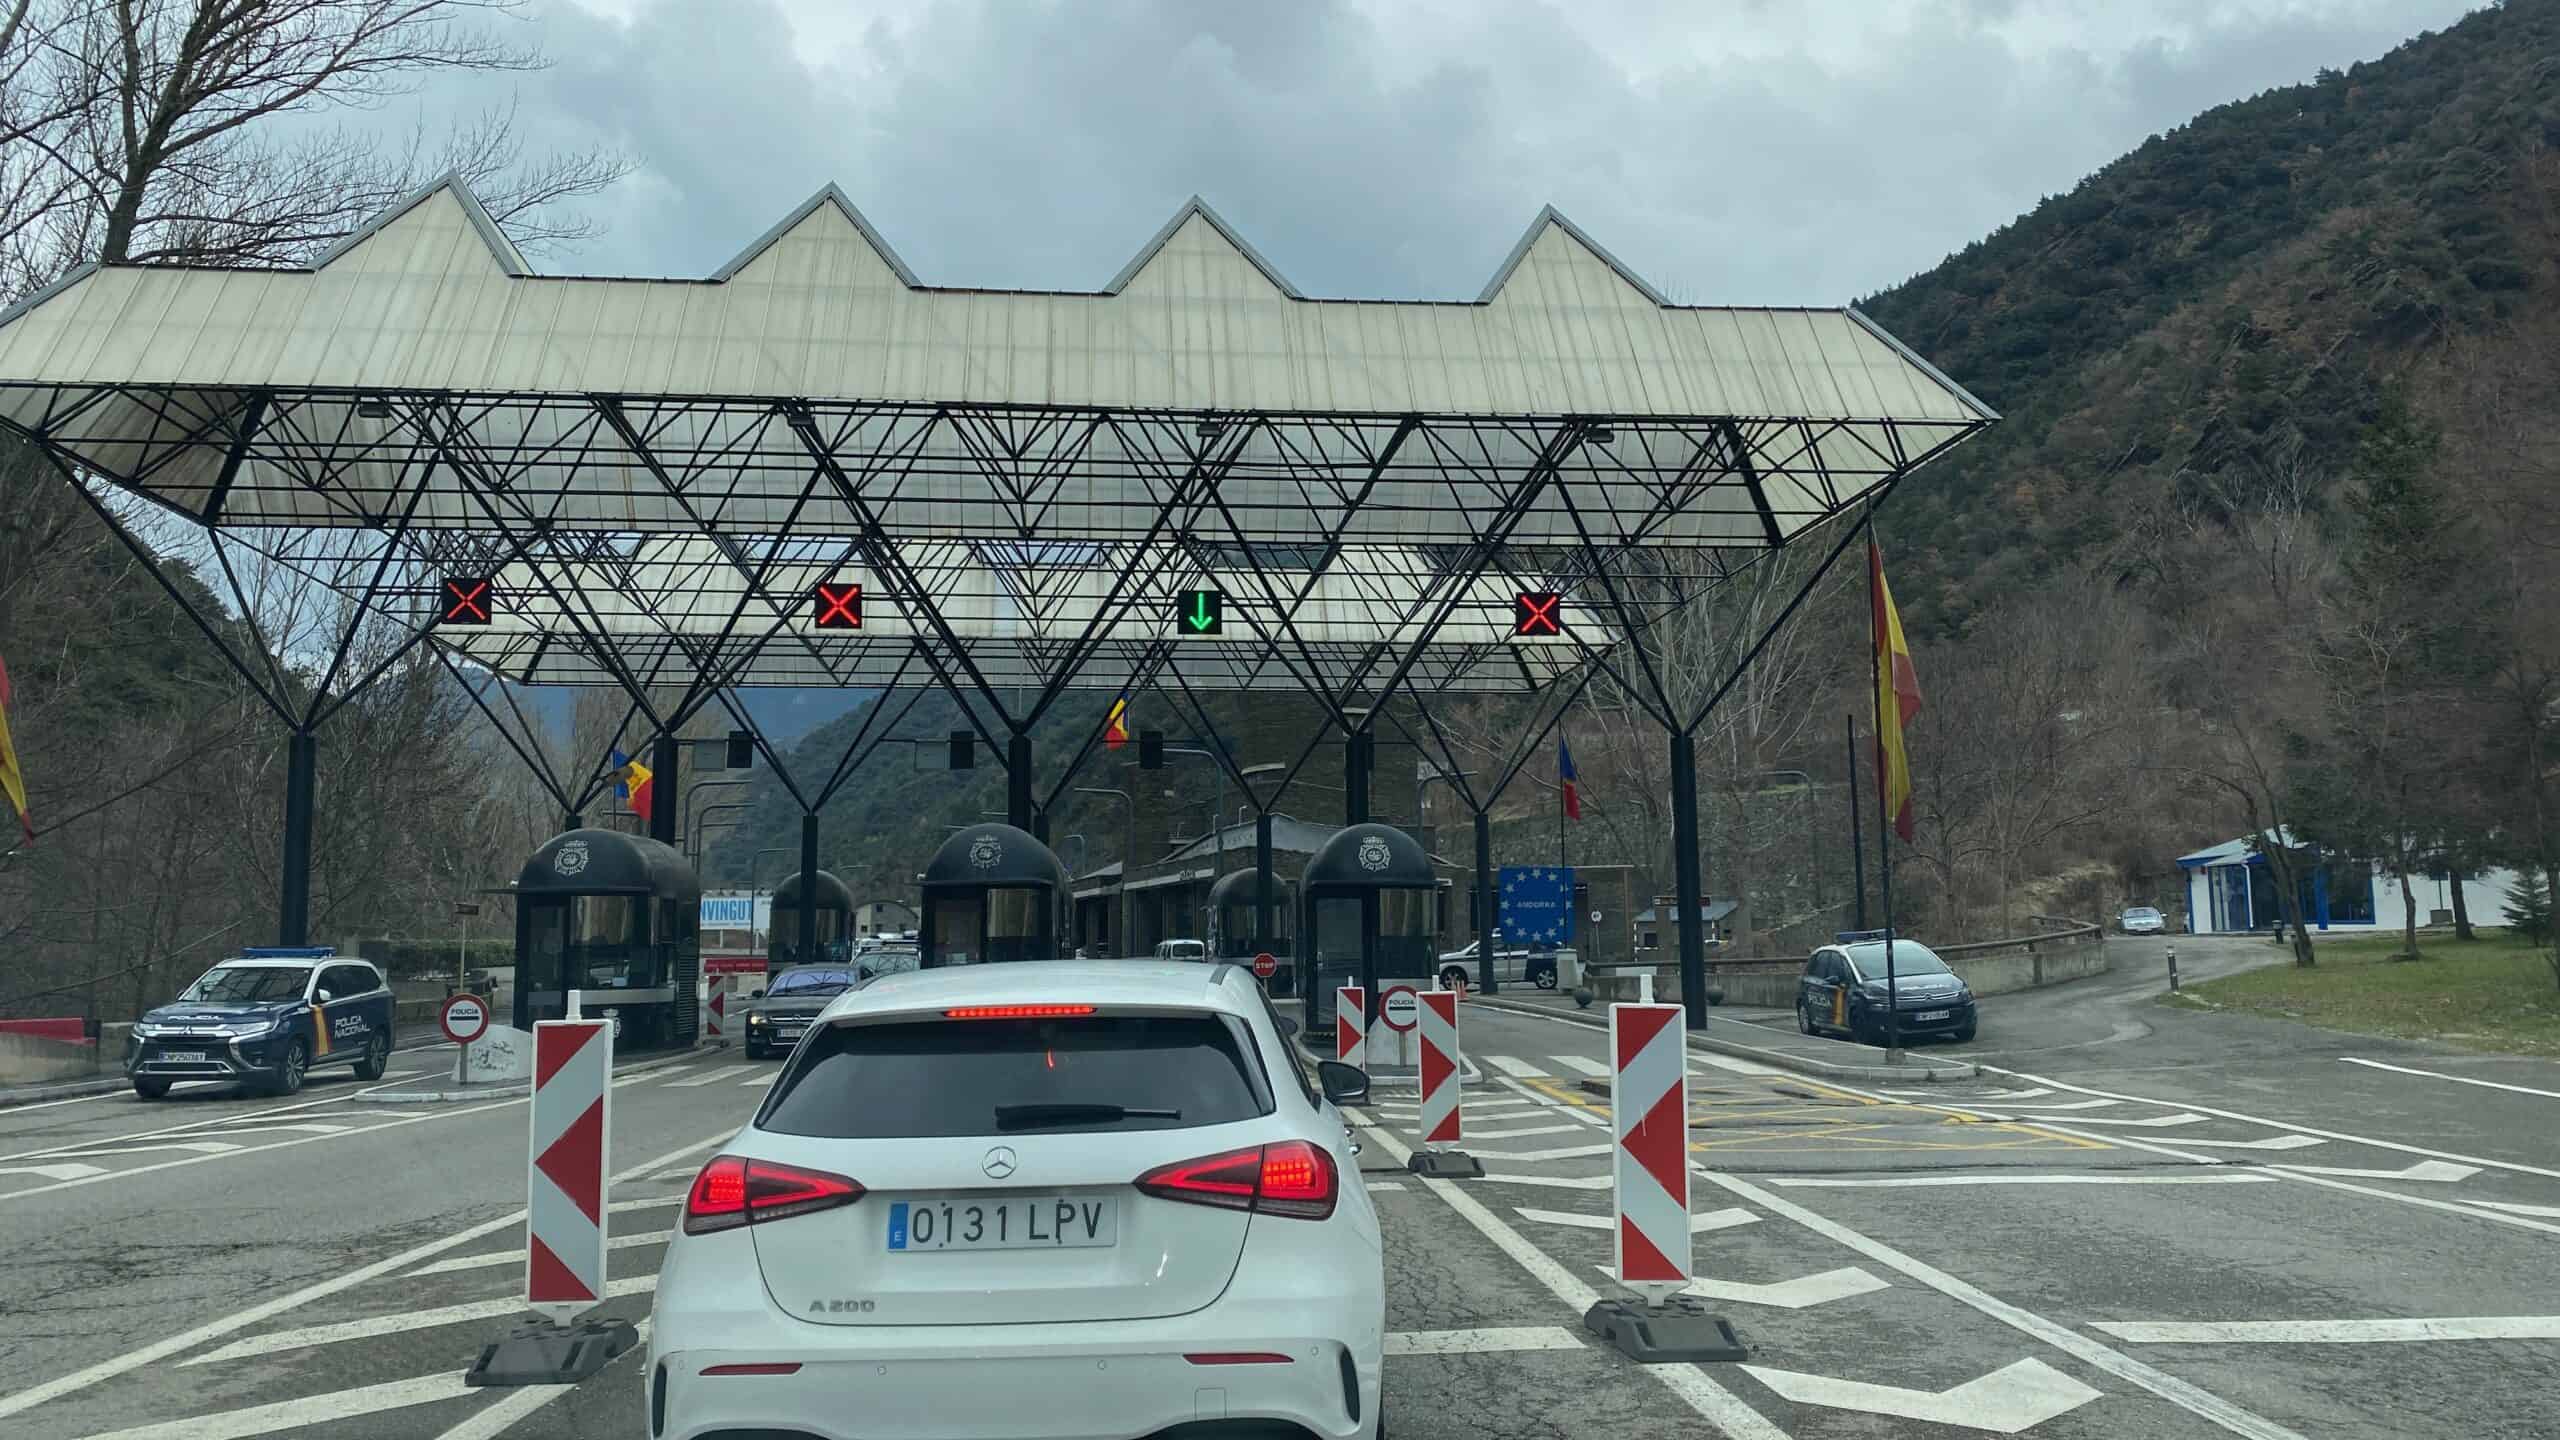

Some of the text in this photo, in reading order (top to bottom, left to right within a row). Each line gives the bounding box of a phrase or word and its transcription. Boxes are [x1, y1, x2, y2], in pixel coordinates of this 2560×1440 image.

[912, 1201, 1103, 1244] 0131 LPV
[809, 1299, 875, 1313] A 200
